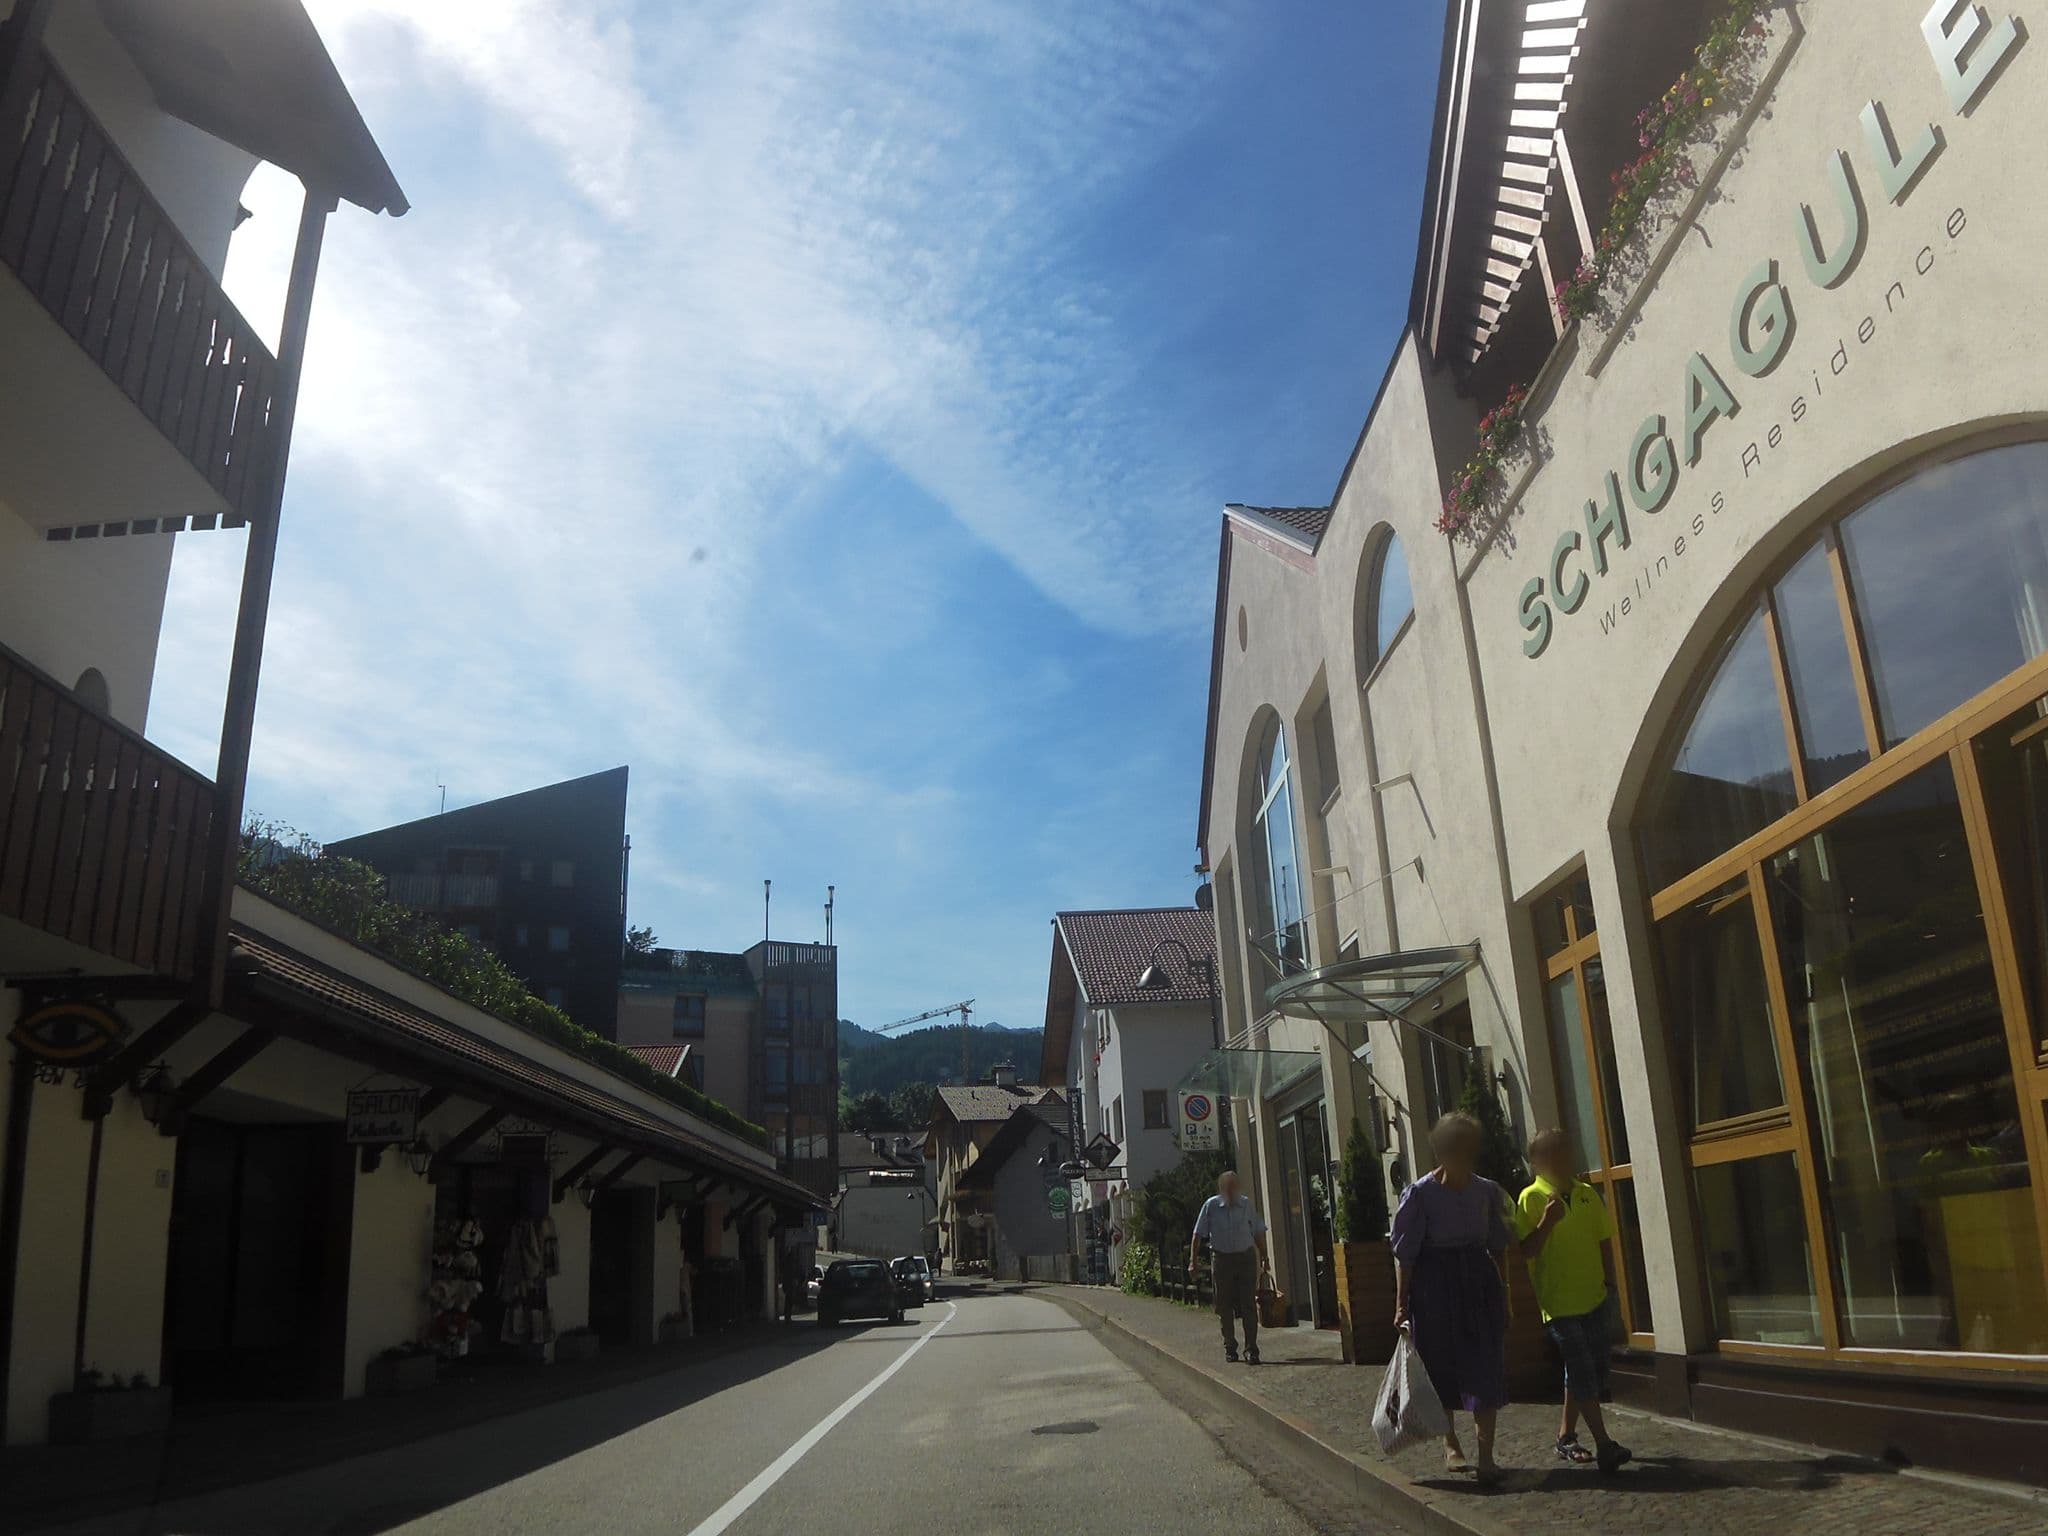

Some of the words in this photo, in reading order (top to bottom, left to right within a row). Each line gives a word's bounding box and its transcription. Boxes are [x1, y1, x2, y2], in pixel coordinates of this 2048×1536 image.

[1517, 0, 2029, 659] SCHGAGULE
[1599, 490, 1725, 637] Wellness
[1741, 206, 1968, 479] Residence
[351, 1094, 415, 1116] SALON
